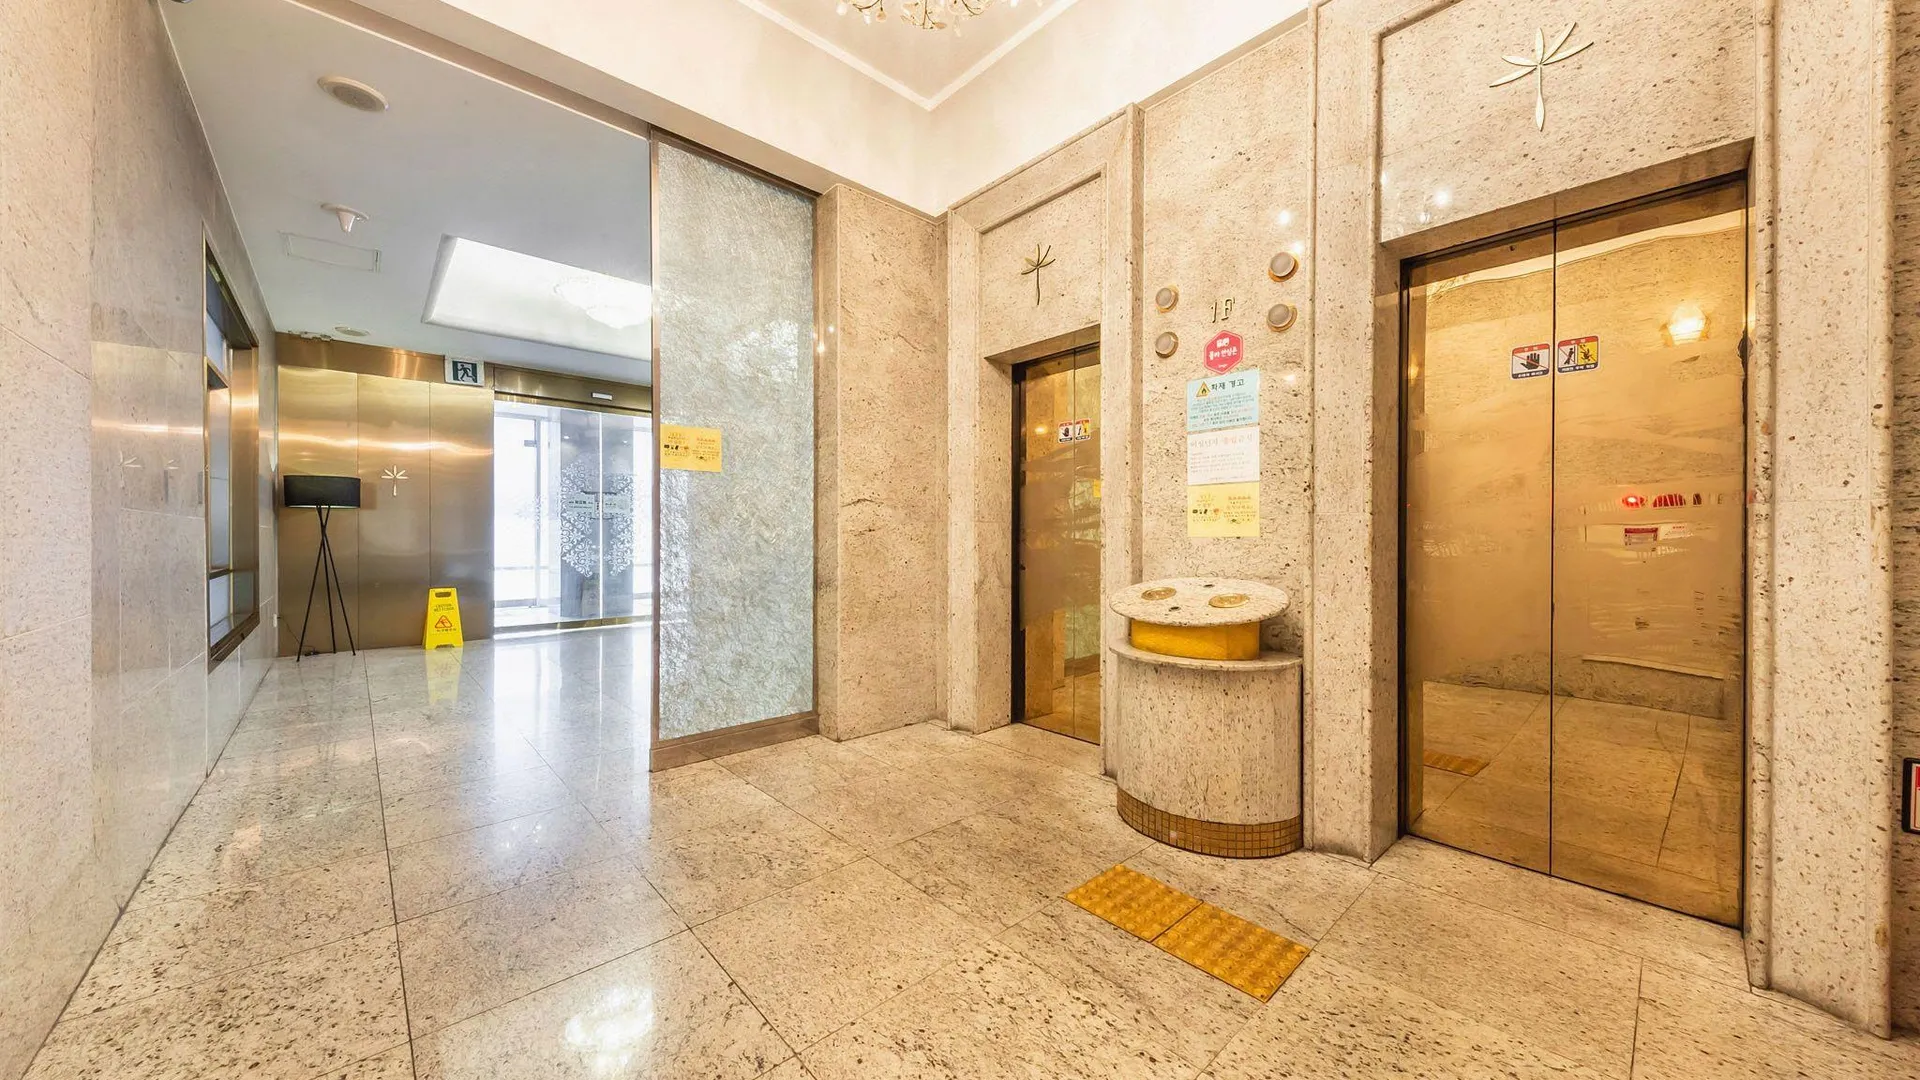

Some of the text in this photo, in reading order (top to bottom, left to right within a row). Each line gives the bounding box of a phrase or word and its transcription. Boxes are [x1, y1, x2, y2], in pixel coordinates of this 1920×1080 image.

[1210, 297, 1235, 323] 1F
[1211, 378, 1245, 391] 화재 경고
